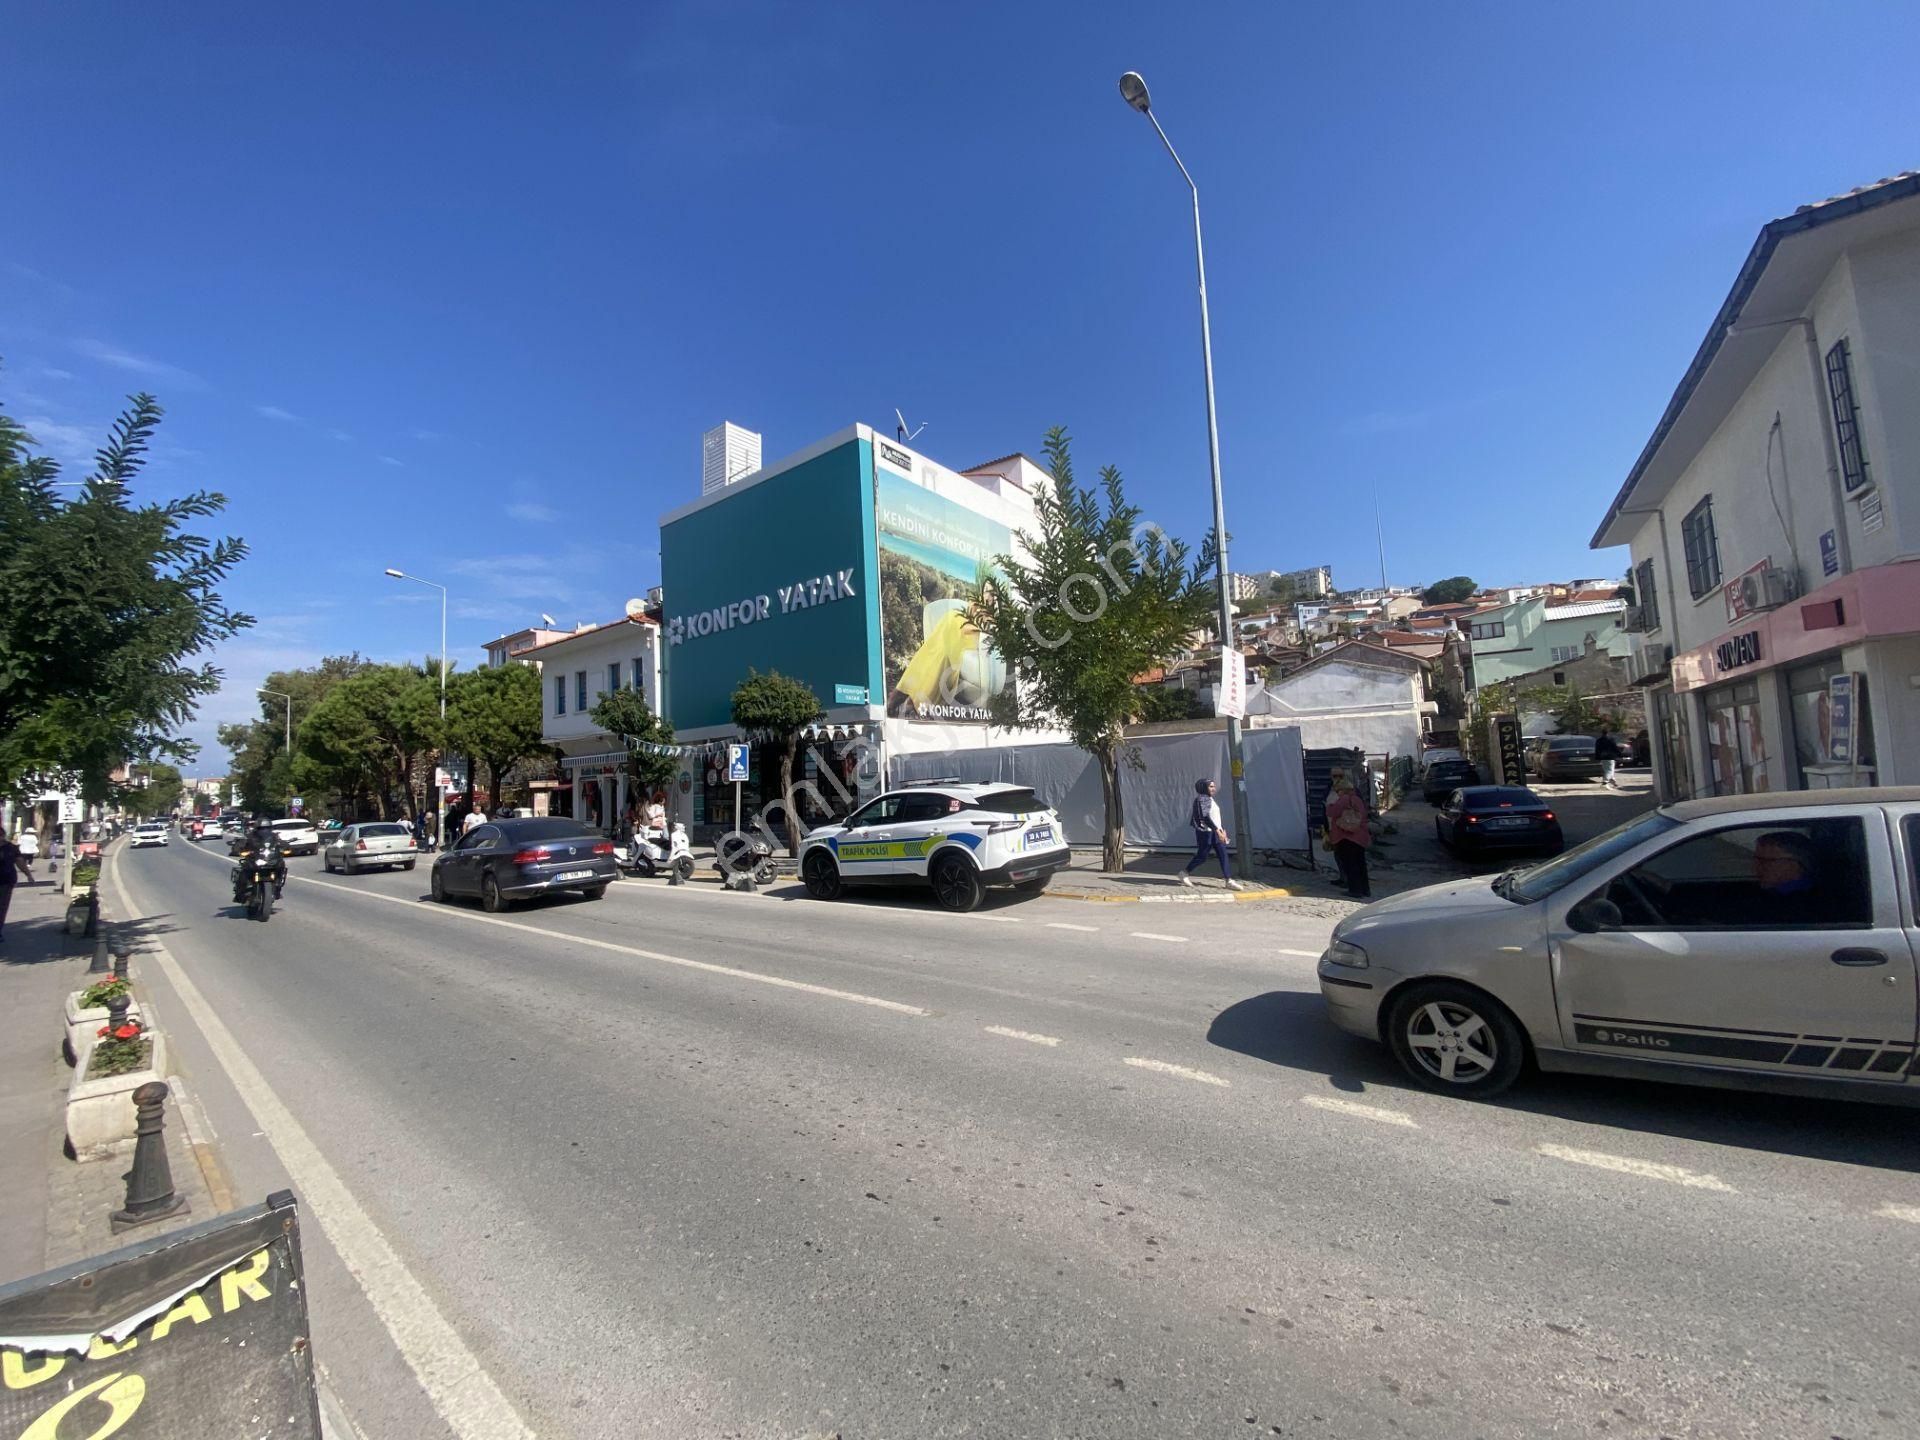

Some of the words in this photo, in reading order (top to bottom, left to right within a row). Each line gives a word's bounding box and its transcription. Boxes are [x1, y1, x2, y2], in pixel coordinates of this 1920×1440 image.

[883, 508, 930, 537] KENDİNİ
[687, 595, 770, 639] KONFOR
[777, 568, 855, 614] YATAK
[1716, 631, 1760, 671] SUWEN
[929, 704, 966, 718] KONFOR
[841, 846, 865, 855] TRAFİK
[1612, 1032, 1670, 1047] Palio
